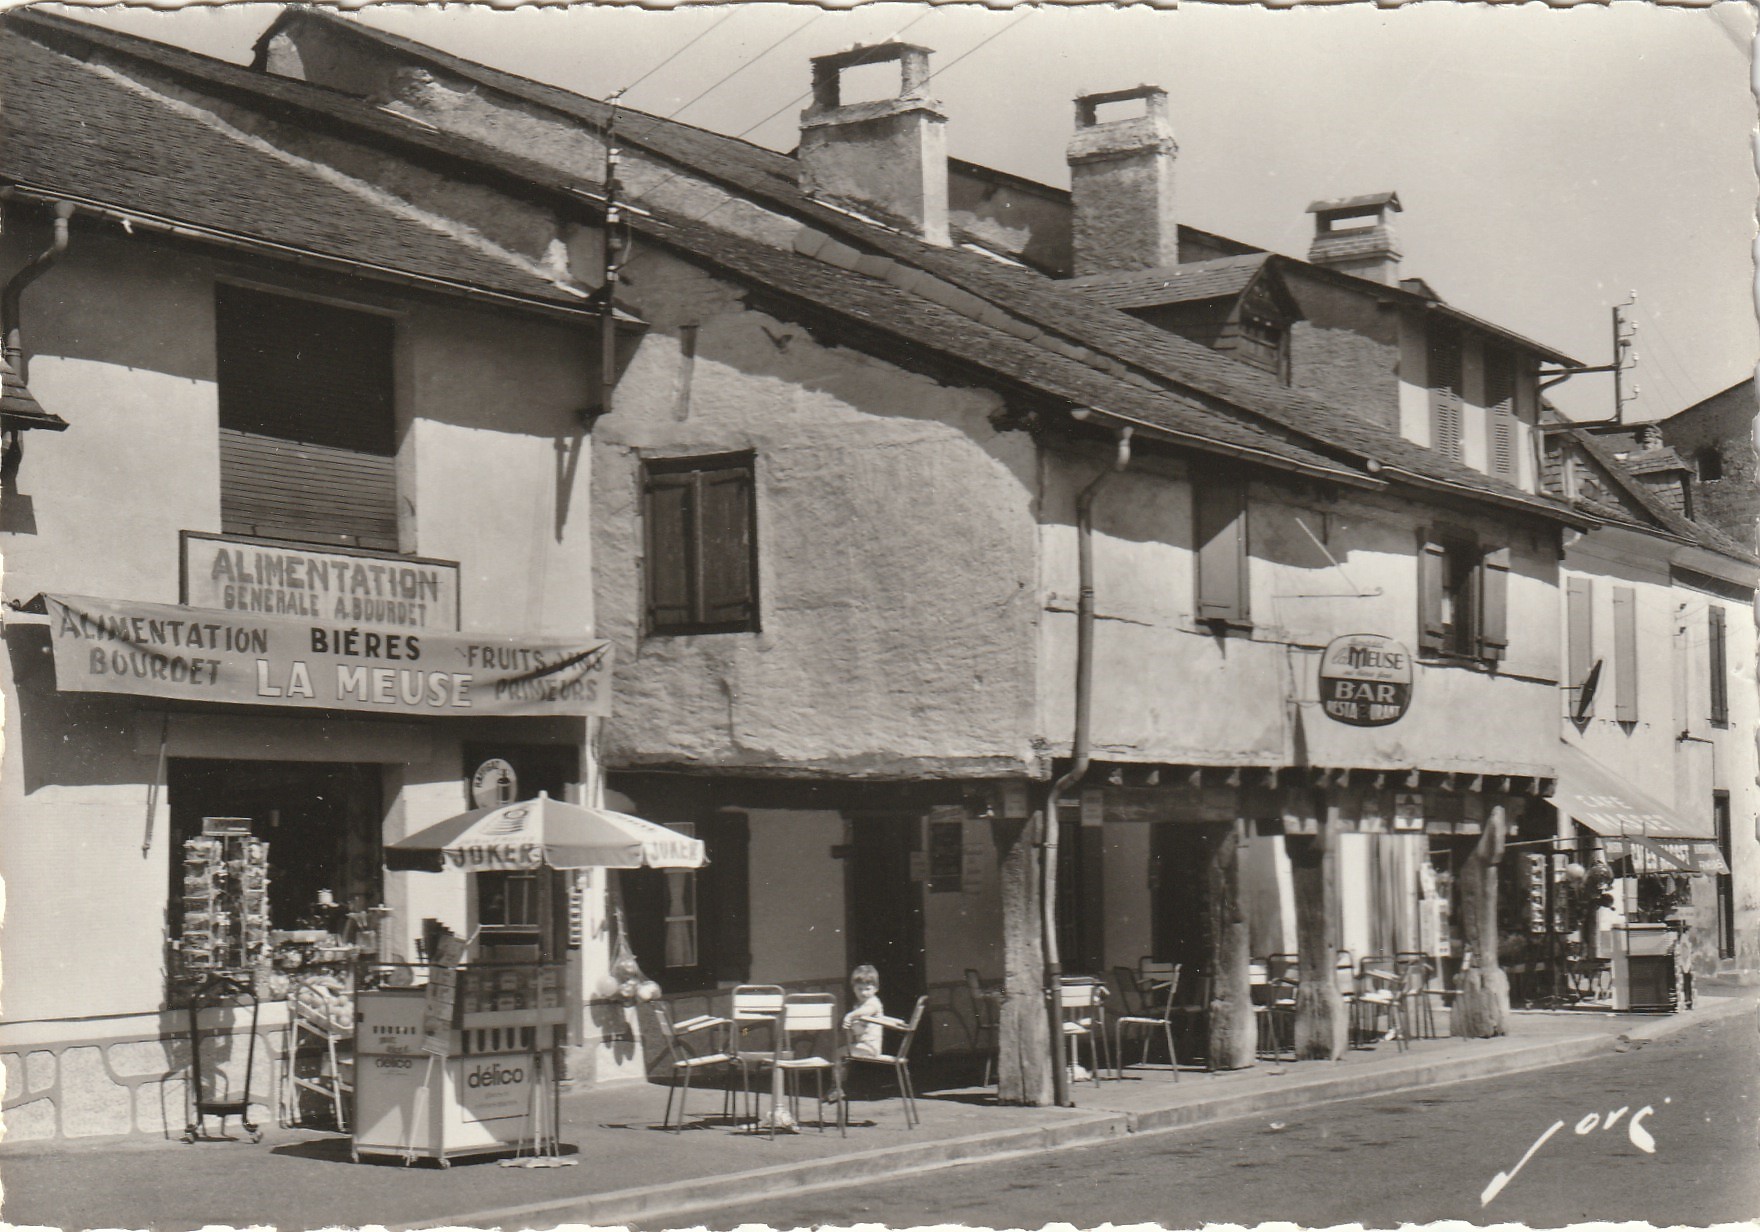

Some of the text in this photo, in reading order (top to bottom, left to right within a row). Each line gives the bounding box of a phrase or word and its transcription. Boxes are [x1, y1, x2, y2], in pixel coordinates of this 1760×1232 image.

[211, 548, 438, 602] ALIMENTATION
[224, 585, 319, 617] GENERALE
[59, 604, 268, 654] ALIMENTATION
[89, 647, 221, 686] BOURDET
[1348, 645, 1403, 670] MEUSE
[256, 658, 473, 708] LA MEUSE
[1335, 681, 1396, 703] BAR
[468, 1063, 524, 1089] délico
